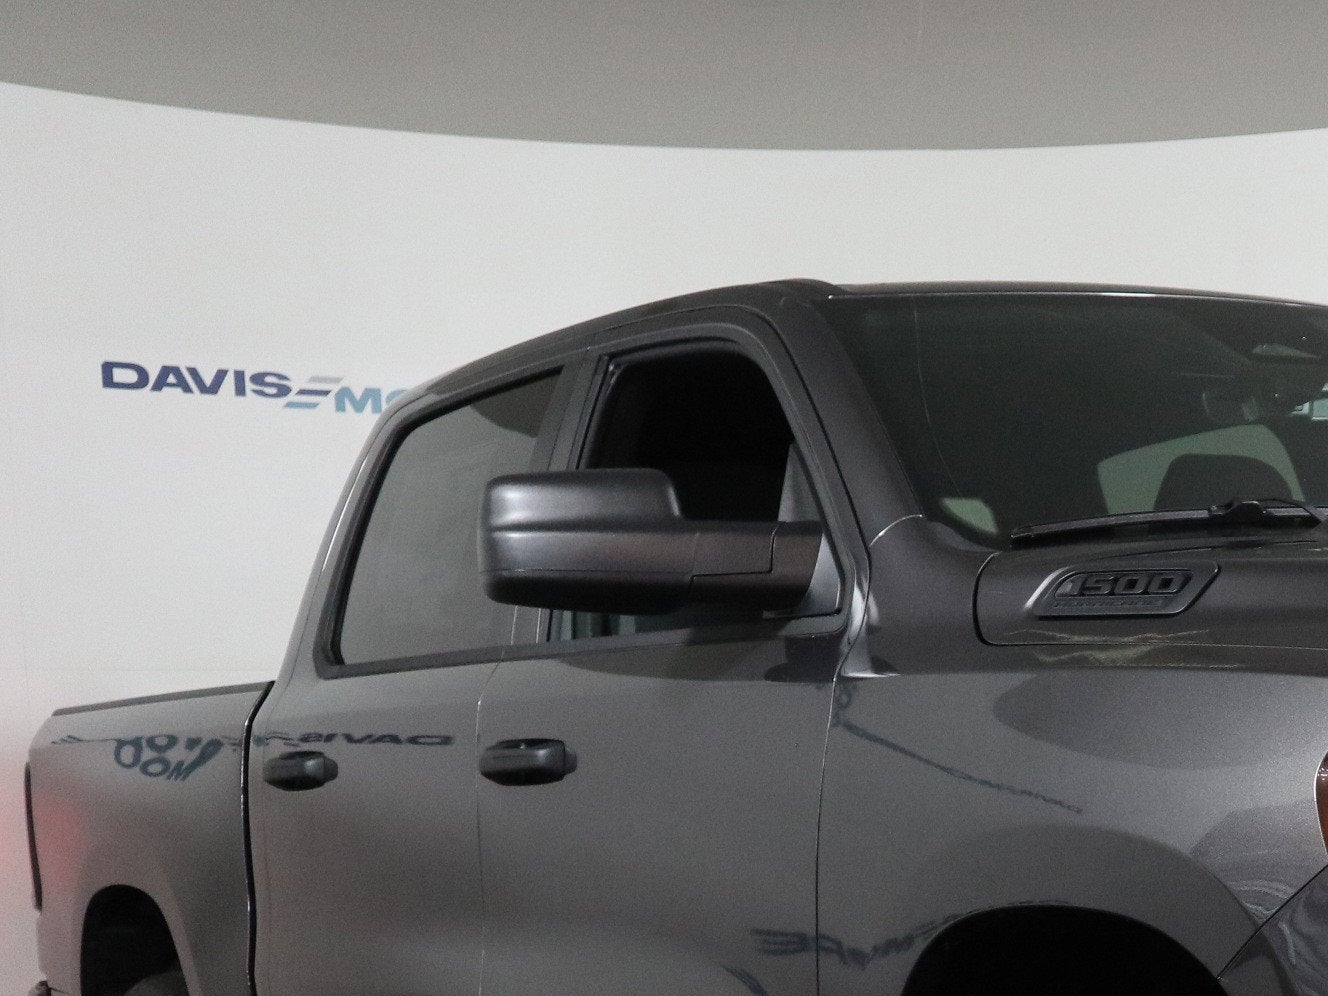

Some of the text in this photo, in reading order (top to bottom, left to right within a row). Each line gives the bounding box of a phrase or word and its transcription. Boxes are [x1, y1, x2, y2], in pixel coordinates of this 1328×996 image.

[101, 361, 407, 414] DAVIS M
[1055, 571, 1190, 597] 1500
